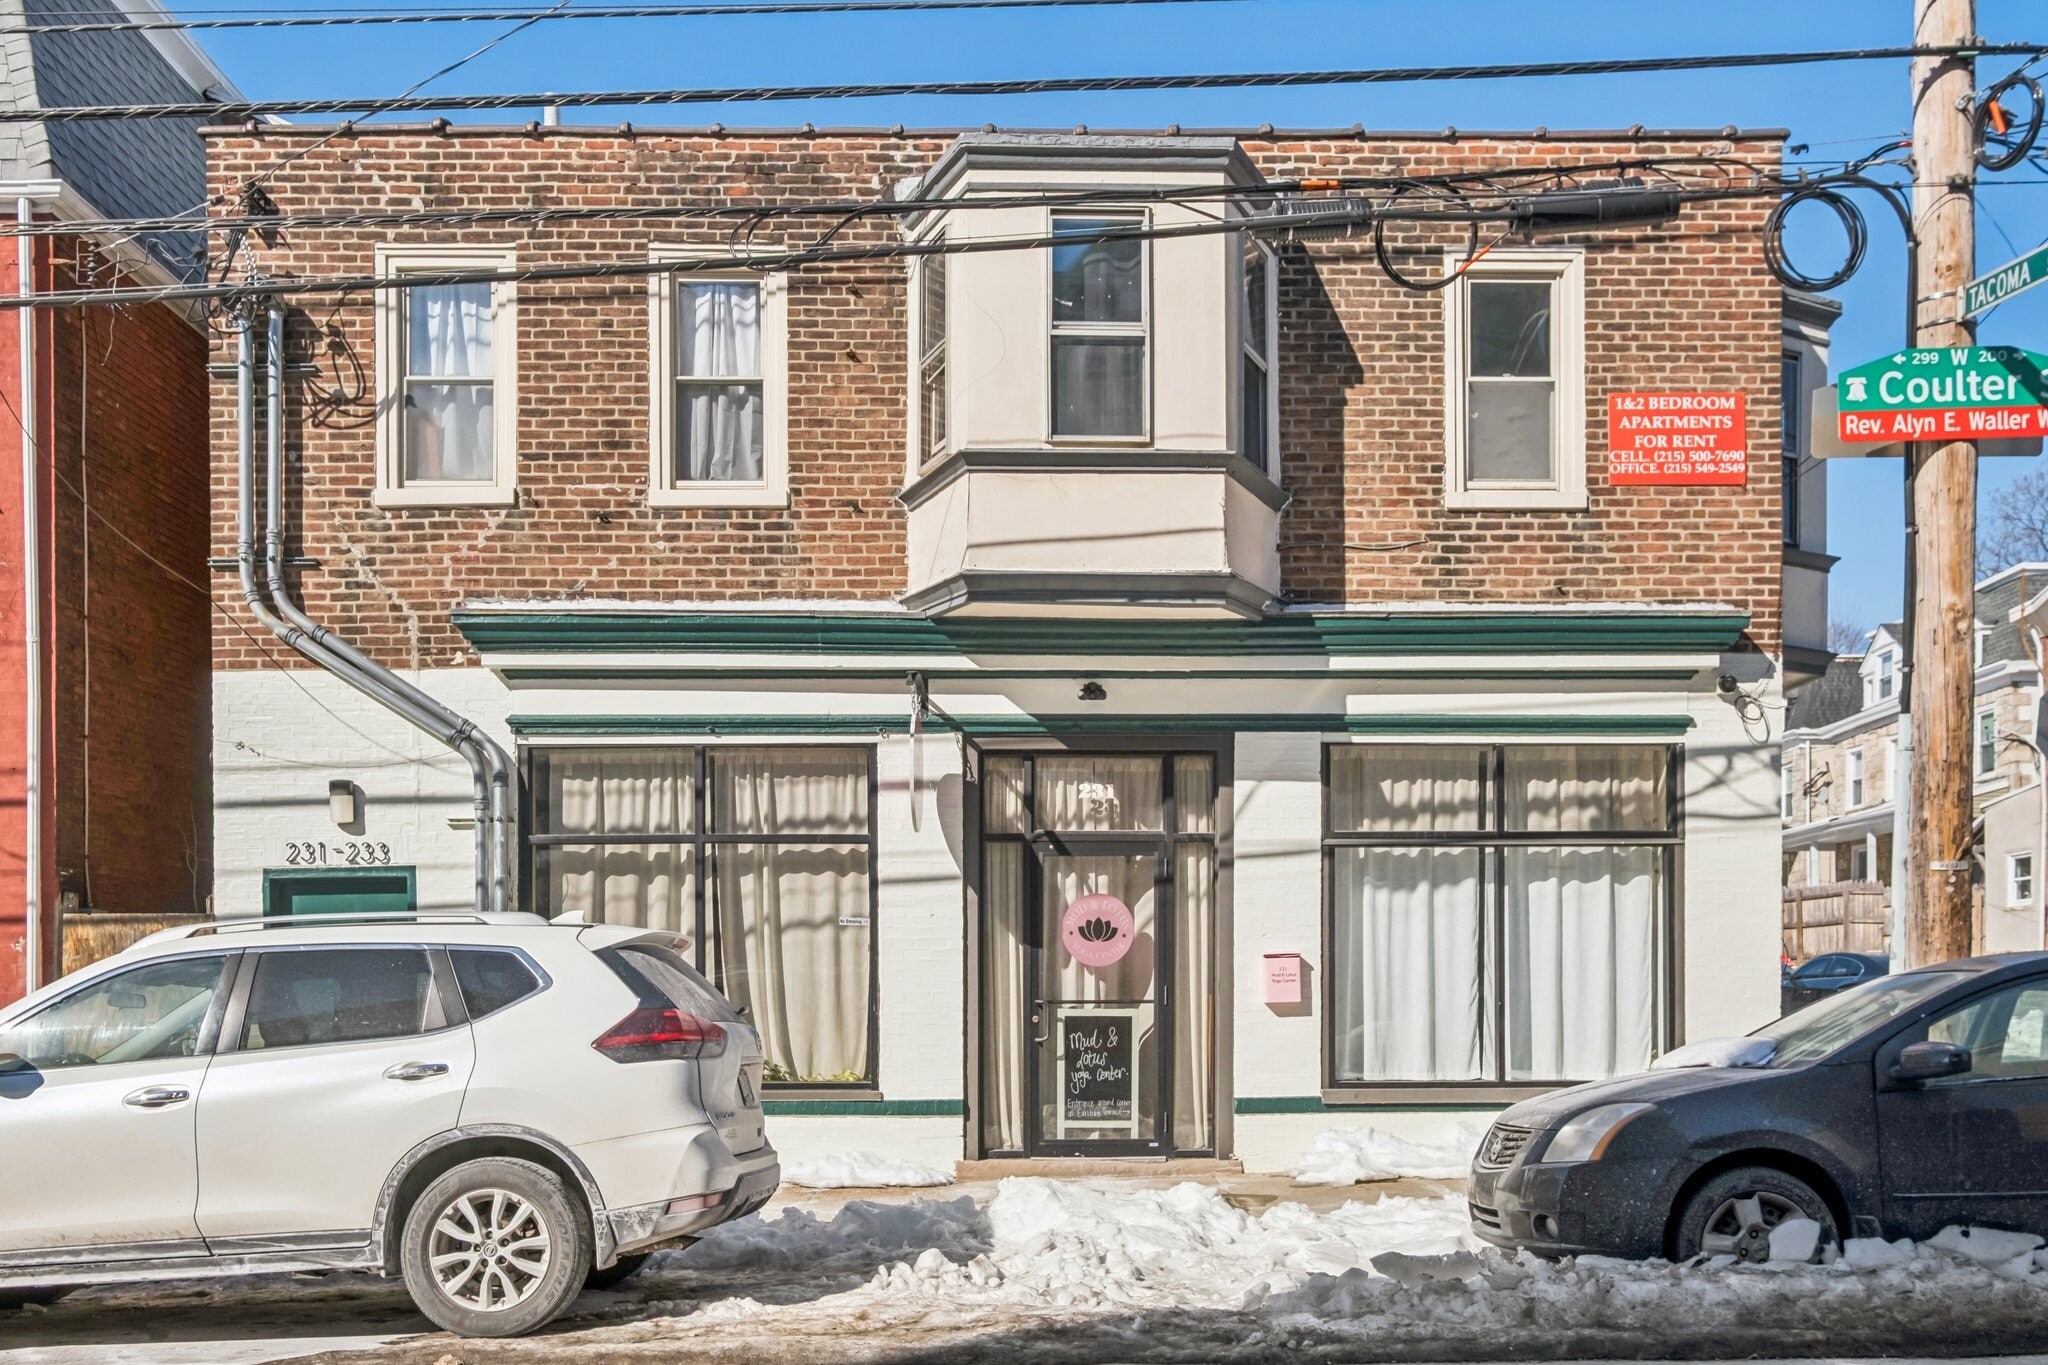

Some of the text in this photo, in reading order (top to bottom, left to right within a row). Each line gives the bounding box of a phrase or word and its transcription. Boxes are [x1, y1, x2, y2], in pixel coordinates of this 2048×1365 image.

[1969, 261, 2031, 310] TACOMA
[1912, 349, 2007, 366] 299 W 200
[1879, 369, 2021, 404] Coulter
[1616, 396, 1736, 410] 1&2 BEDROOM
[1619, 415, 1733, 429] APARTMENTS
[1845, 415, 1885, 435] Rev.
[1892, 413, 1936, 438] Alyn
[1944, 412, 1961, 432] E.
[1968, 410, 2031, 431] Waller
[1635, 434, 1718, 448] FOR RENT
[1610, 450, 1745, 463] CELL. (215) 500-7690
[1610, 463, 1745, 474] OFFICE. (215) 549-2549
[1079, 783, 1114, 800] 231
[286, 841, 391, 865] 231-233
[1069, 1026, 1119, 1051] Mud &
